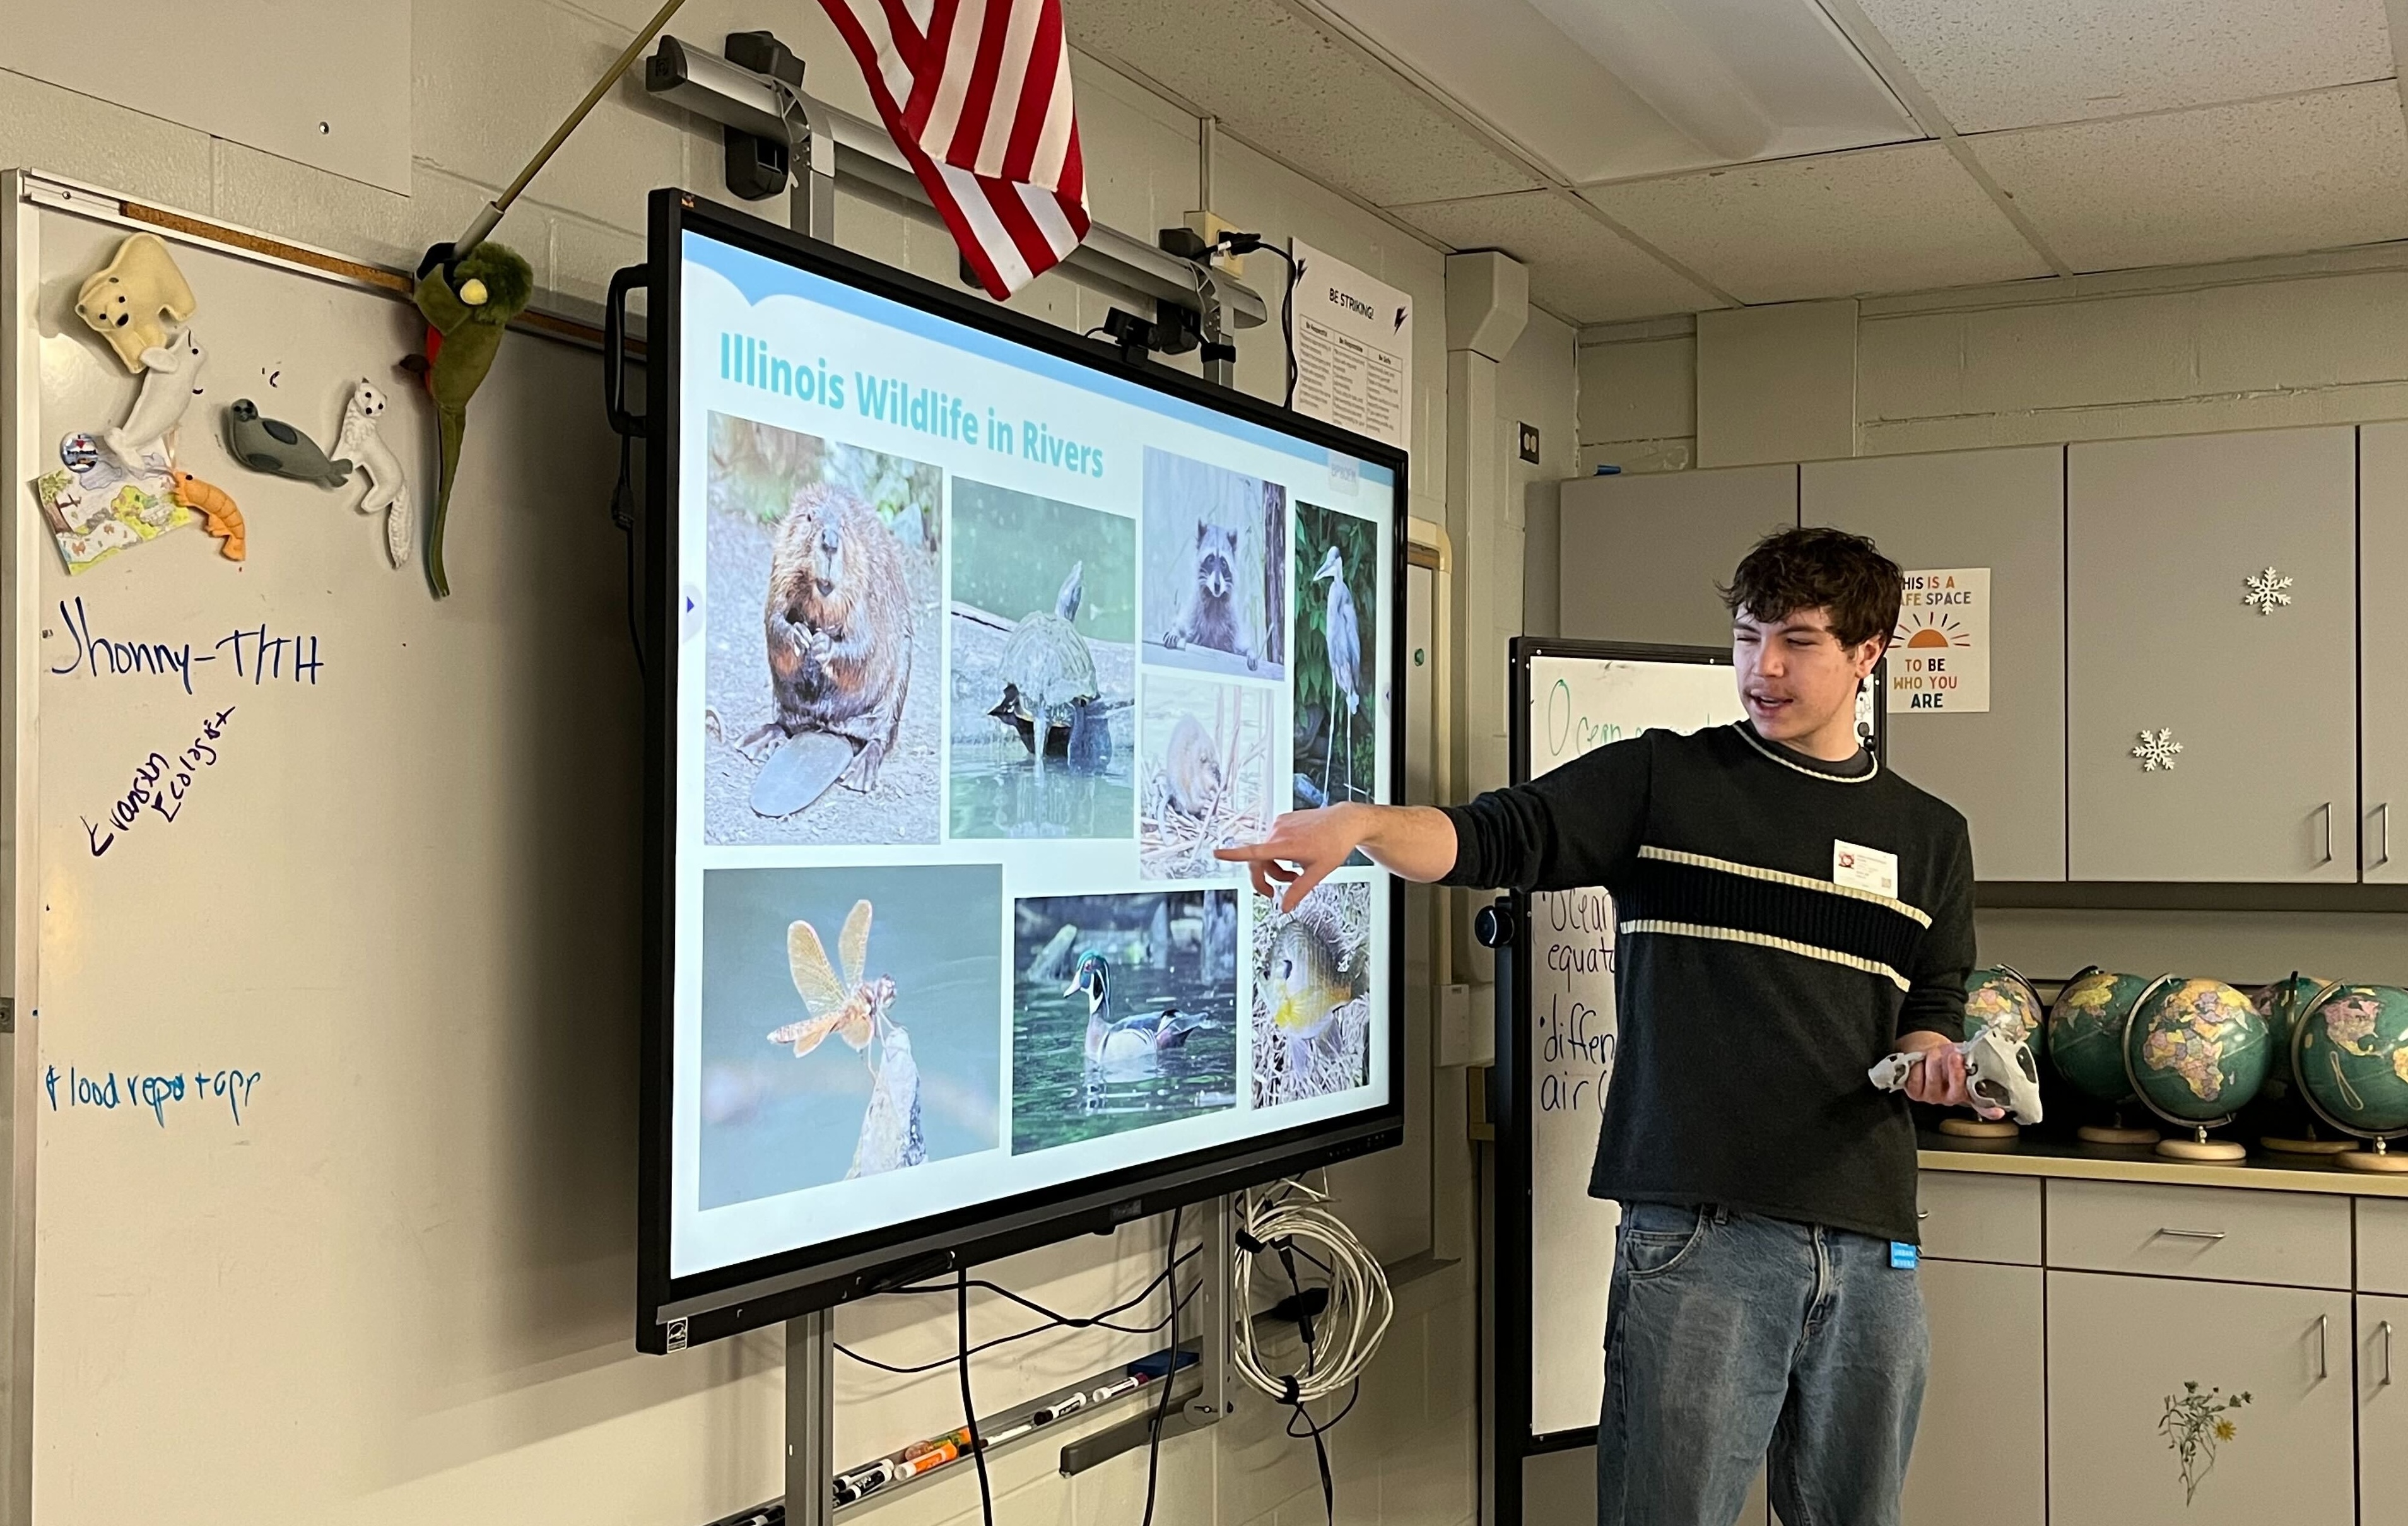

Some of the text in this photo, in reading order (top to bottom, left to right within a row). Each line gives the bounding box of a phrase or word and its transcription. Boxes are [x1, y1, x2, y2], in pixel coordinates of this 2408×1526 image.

[1329, 288, 1374, 320] BE STRIKING!
[720, 332, 1103, 478] Illinois Wildlife in Rivers
[1902, 575, 1955, 590] HIS IS A
[1901, 592, 1971, 606] FE SPACE
[1905, 659, 1945, 672] TO BE
[1893, 676, 1958, 690] WHO YOU
[1910, 693, 1944, 708] ARE
[1541, 1071, 1589, 1111] air
